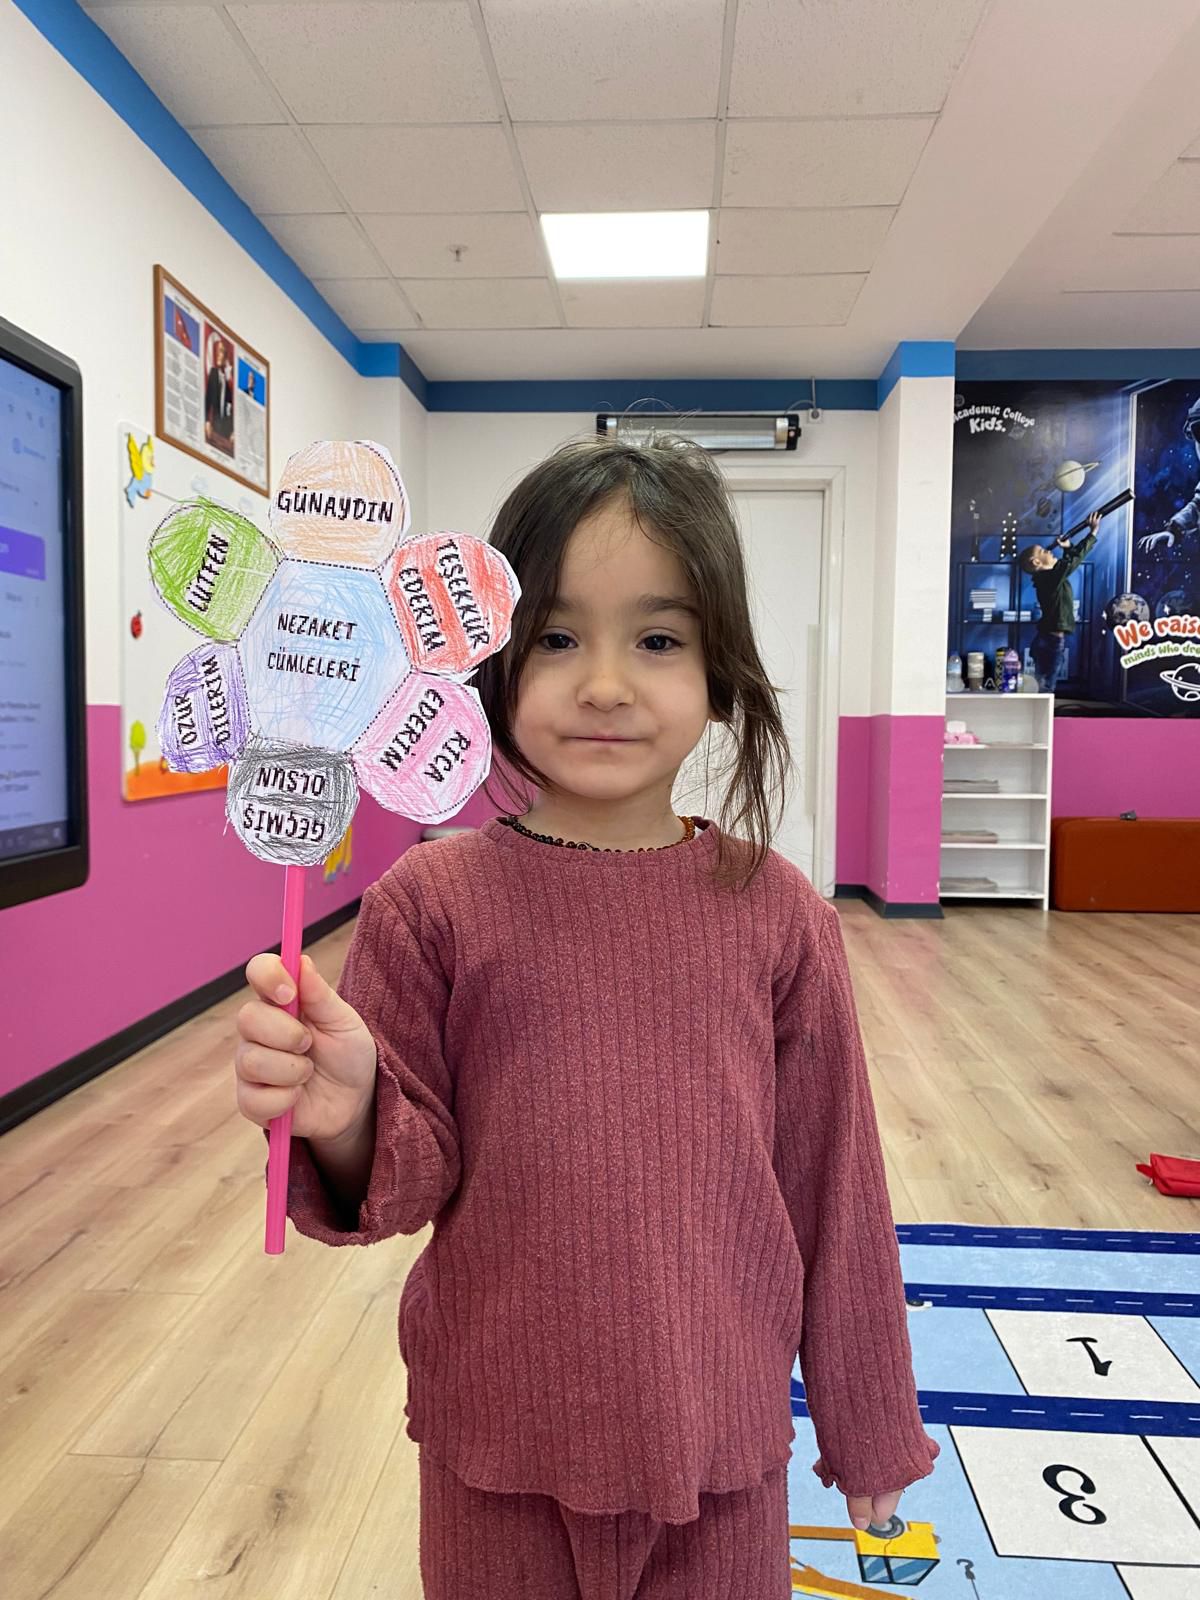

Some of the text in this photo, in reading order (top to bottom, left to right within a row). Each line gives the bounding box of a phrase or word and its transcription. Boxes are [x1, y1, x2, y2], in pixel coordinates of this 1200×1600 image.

[969, 416, 1007, 434] Kids.
[1002, 407, 1035, 428] College
[277, 486, 394, 523] GÜNAYDIN
[186, 534, 229, 612] LÜTFEN
[398, 567, 446, 652] EDERİM
[436, 539, 491, 649] TEŞEKKÜR
[277, 613, 358, 641] NEZAKET
[1115, 617, 1200, 649] We rais
[267, 647, 361, 682] CÜMLELERİ
[1123, 646, 1156, 666] minds
[201, 654, 231, 746] DİLERİM
[380, 688, 445, 771] EDERİM
[424, 730, 471, 782] RİCA
[255, 767, 326, 797] OLSUN
[243, 803, 326, 843] GEÇMİŞ
[1065, 1337, 1113, 1377] 1
[1041, 1464, 1107, 1525] 3
